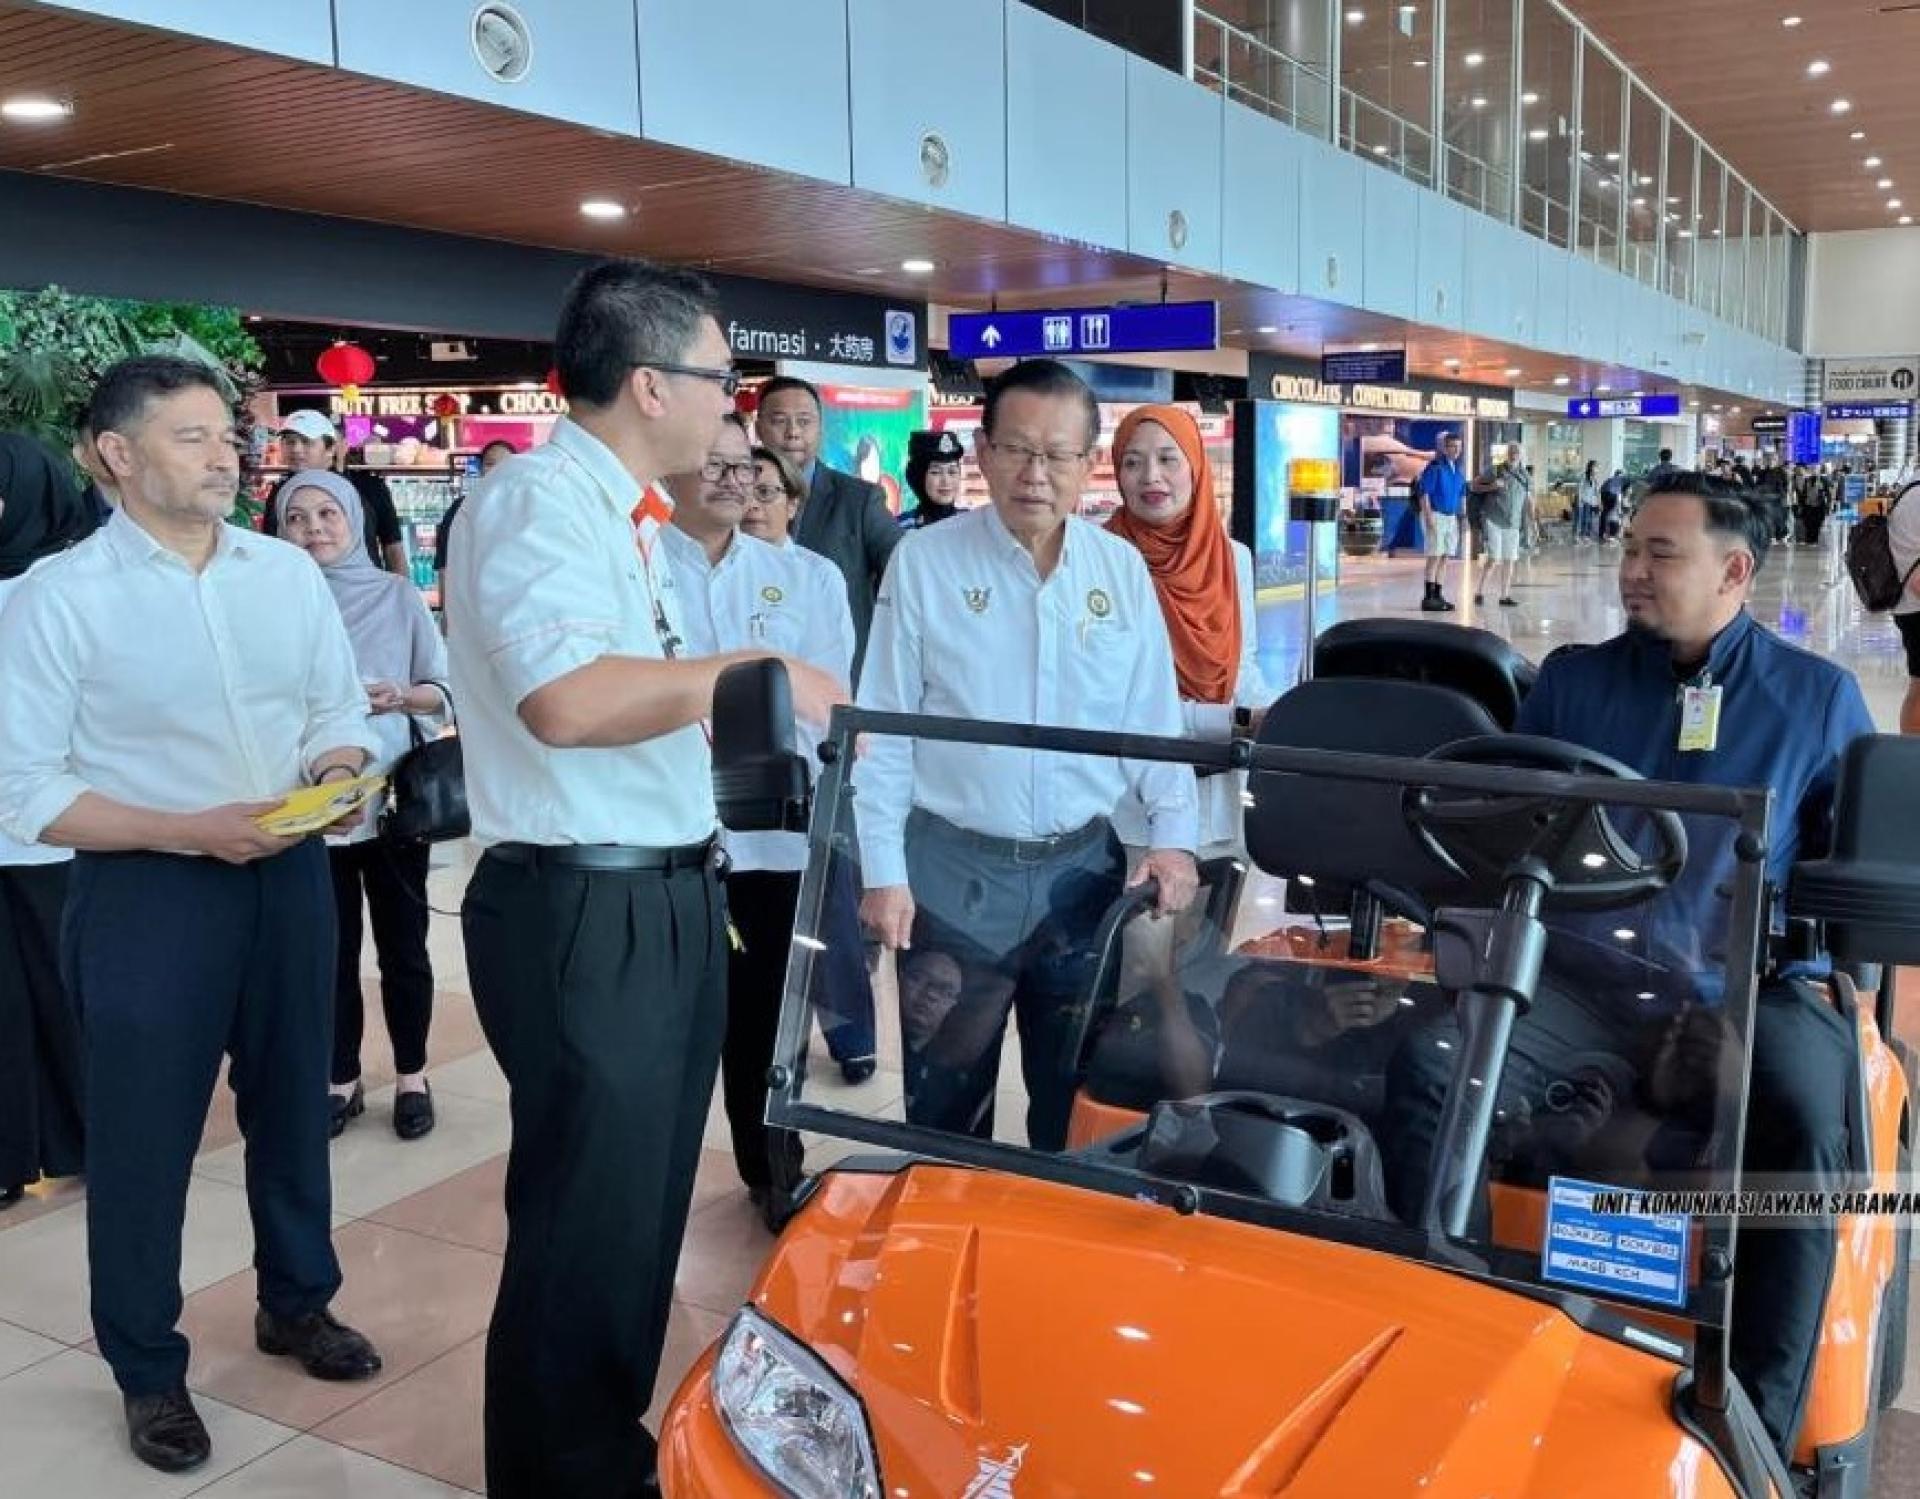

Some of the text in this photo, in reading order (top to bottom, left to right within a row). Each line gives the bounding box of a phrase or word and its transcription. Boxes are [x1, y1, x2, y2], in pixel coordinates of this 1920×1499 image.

[728, 321, 874, 362] farmasi 大药房
[1829, 377, 1853, 390] FOOD
[379, 394, 421, 416] FREE
